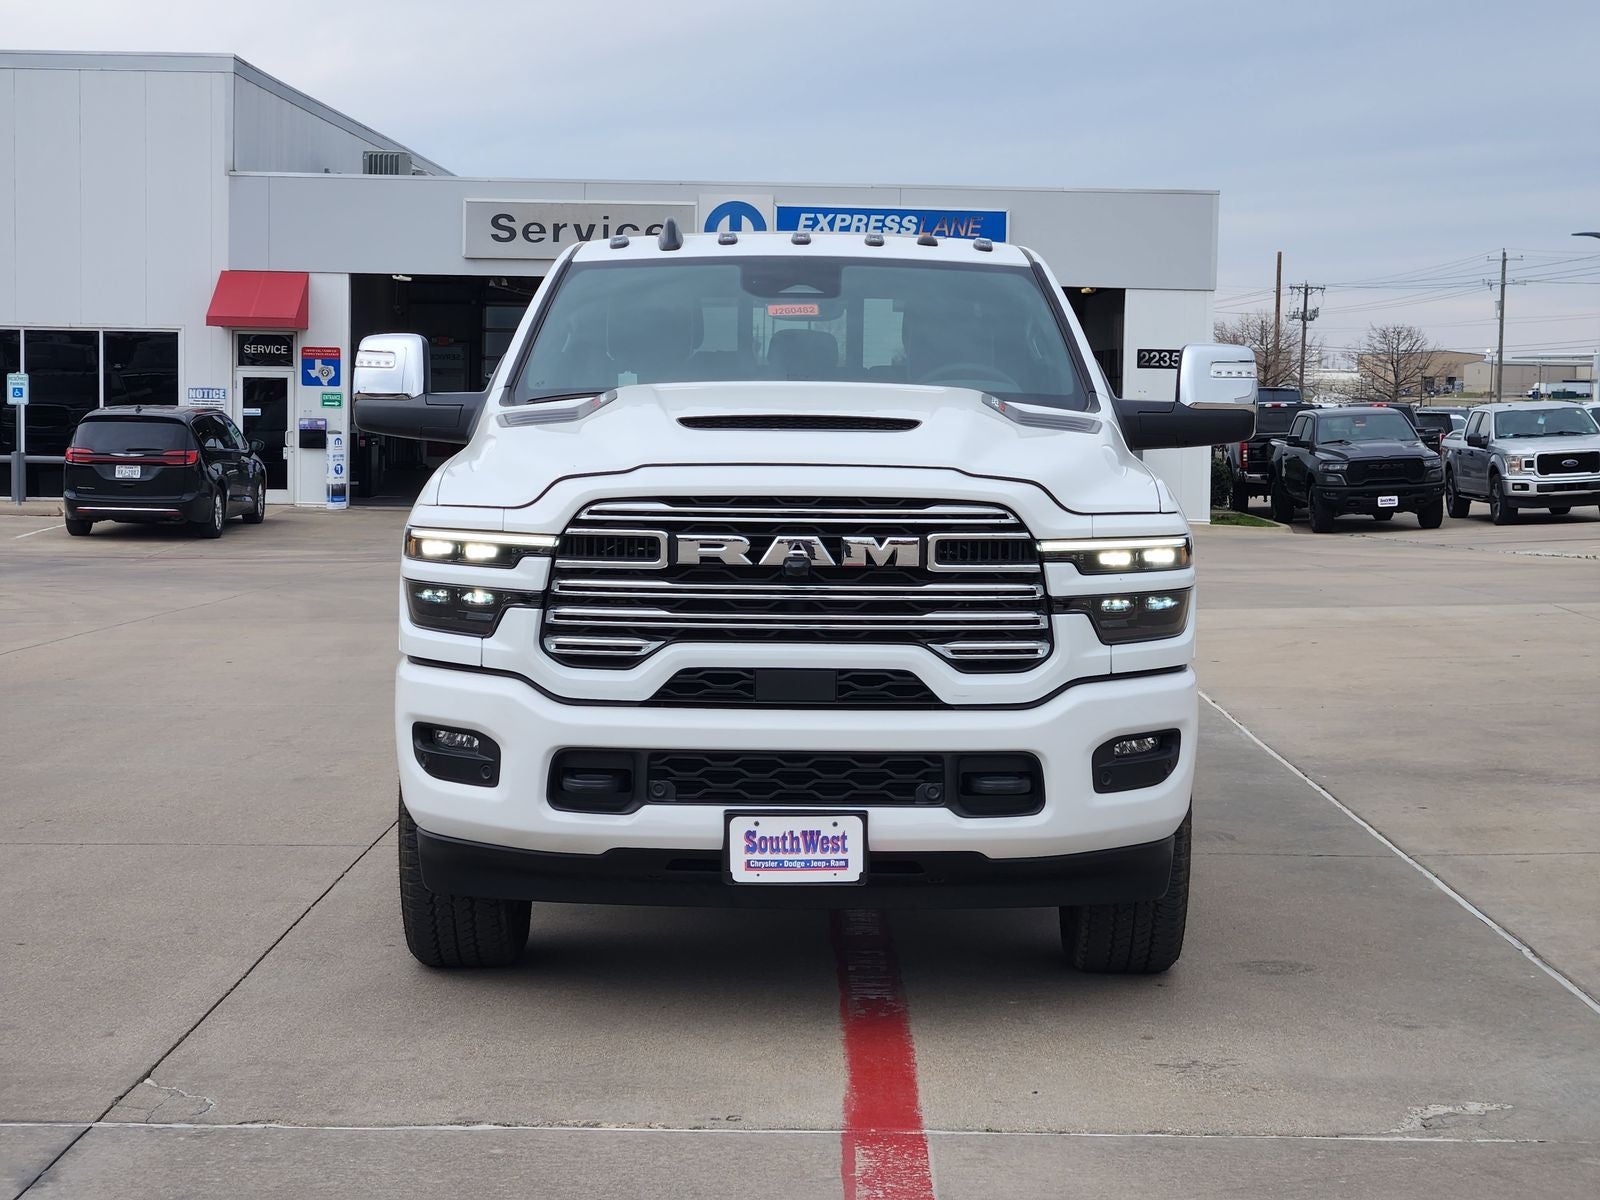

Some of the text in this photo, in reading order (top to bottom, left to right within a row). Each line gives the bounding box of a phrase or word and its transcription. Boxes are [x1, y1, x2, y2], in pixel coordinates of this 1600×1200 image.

[243, 344, 288, 354] SERVICE
[1140, 351, 1180, 367] 2235
[189, 388, 225, 399] NOTICE
[675, 534, 920, 567] RAM
[744, 829, 848, 855] SouthWest
[750, 859, 846, 868] Chrysler Dodge Jeep Ram
